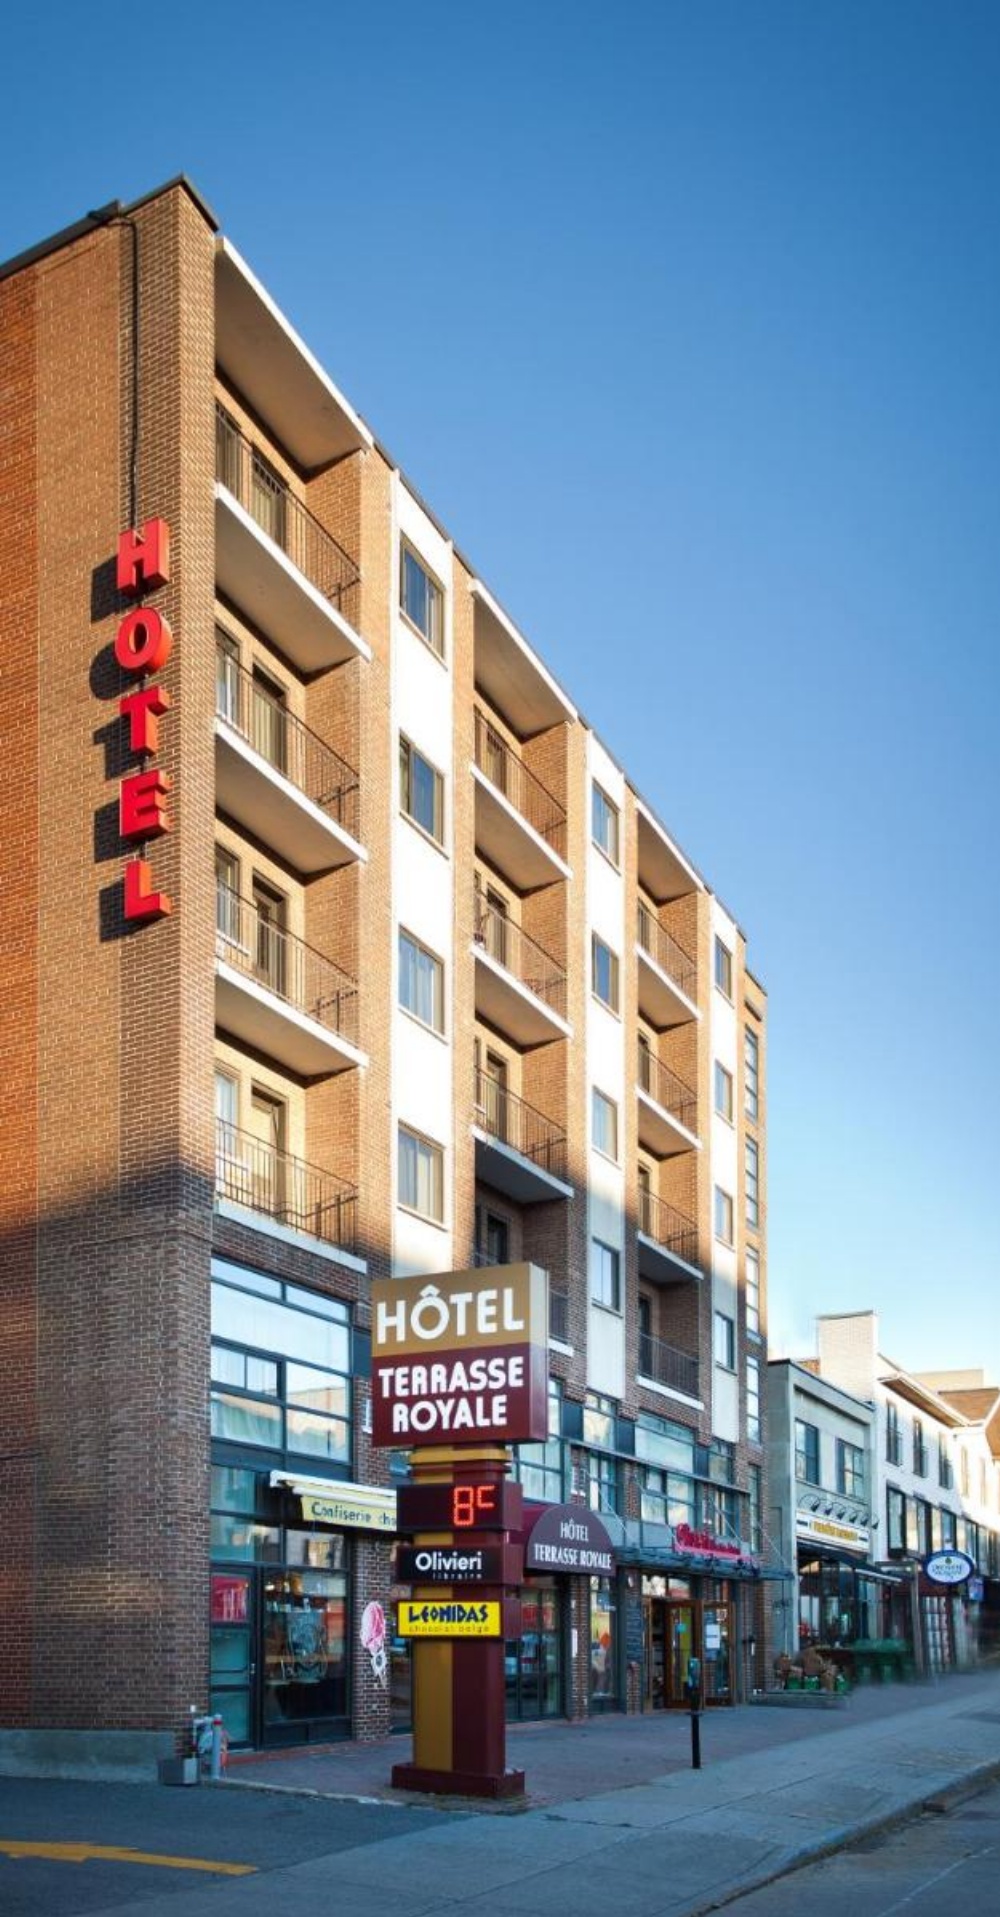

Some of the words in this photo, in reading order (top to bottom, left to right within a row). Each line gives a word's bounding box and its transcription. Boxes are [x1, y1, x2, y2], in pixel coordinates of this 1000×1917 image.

[114, 517, 171, 921] HOTEL
[376, 1284, 525, 1344] HÔTEL
[378, 1356, 524, 1398] TERRASSE
[392, 1395, 508, 1433] ROYALE
[560, 1518, 589, 1542] HÔTEL
[415, 1551, 482, 1571] Olivieri
[534, 1543, 578, 1566] TERRASSE
[580, 1549, 612, 1570] ROYALE
